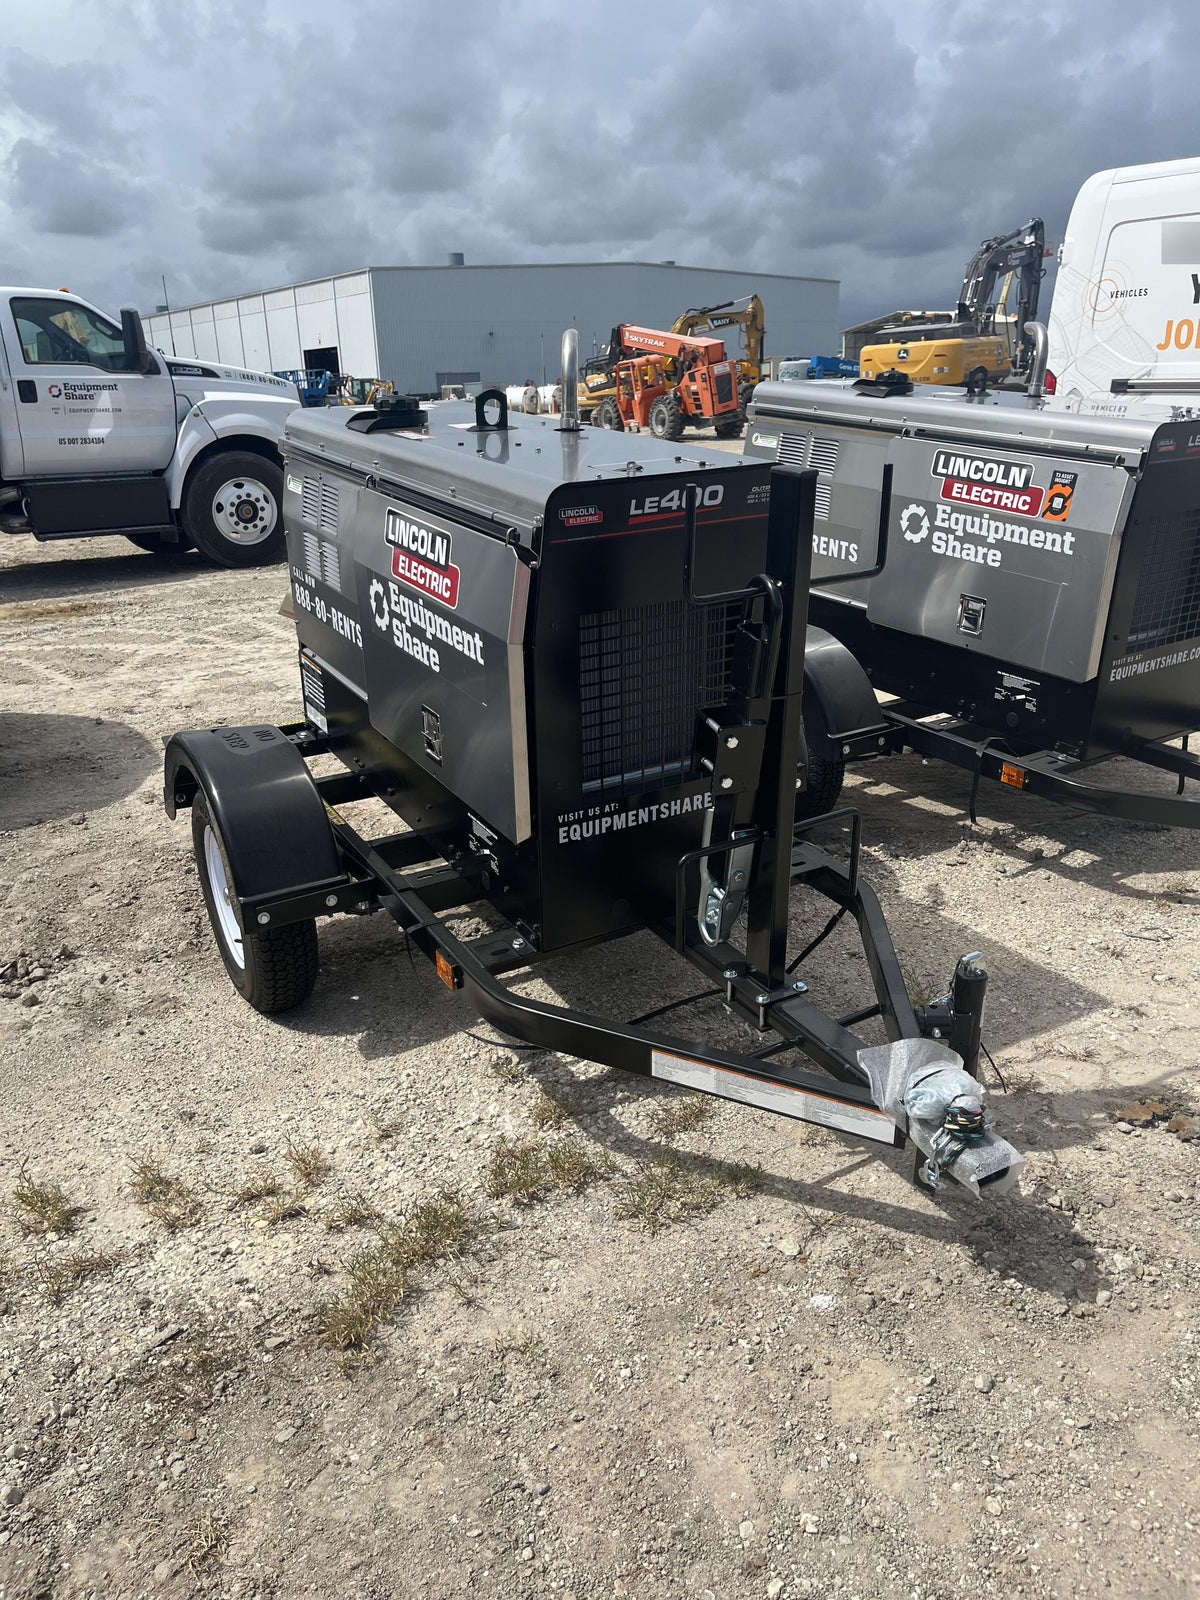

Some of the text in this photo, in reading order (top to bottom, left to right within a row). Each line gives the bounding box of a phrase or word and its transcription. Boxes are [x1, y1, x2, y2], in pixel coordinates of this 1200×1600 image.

[1110, 288, 1148, 299] VEHICLES
[629, 335, 665, 347] SKYTRAK
[63, 383, 118, 393] Equipment
[65, 392, 95, 400] Share
[58, 437, 67, 445] US
[67, 437, 79, 445] DOT
[936, 454, 1028, 488] LINCOLN
[951, 481, 1031, 511] ELECTRIC
[561, 507, 595, 518] LINCOLN
[570, 515, 599, 524] ELECTRIC
[387, 514, 448, 567] LINCOLN
[934, 504, 1075, 555] Equipment
[931, 532, 1002, 568] Share
[293, 566, 316, 589] CALL NOW
[398, 555, 452, 599] ELECTRIC
[294, 582, 363, 648] 888-80-RENTS
[388, 580, 485, 666] Equipment
[392, 617, 441, 673] Share
[222, 732, 250, 749] STEP
[557, 803, 619, 824] VISIT US AT:
[558, 791, 713, 844] EQUIPMENTSHARE
